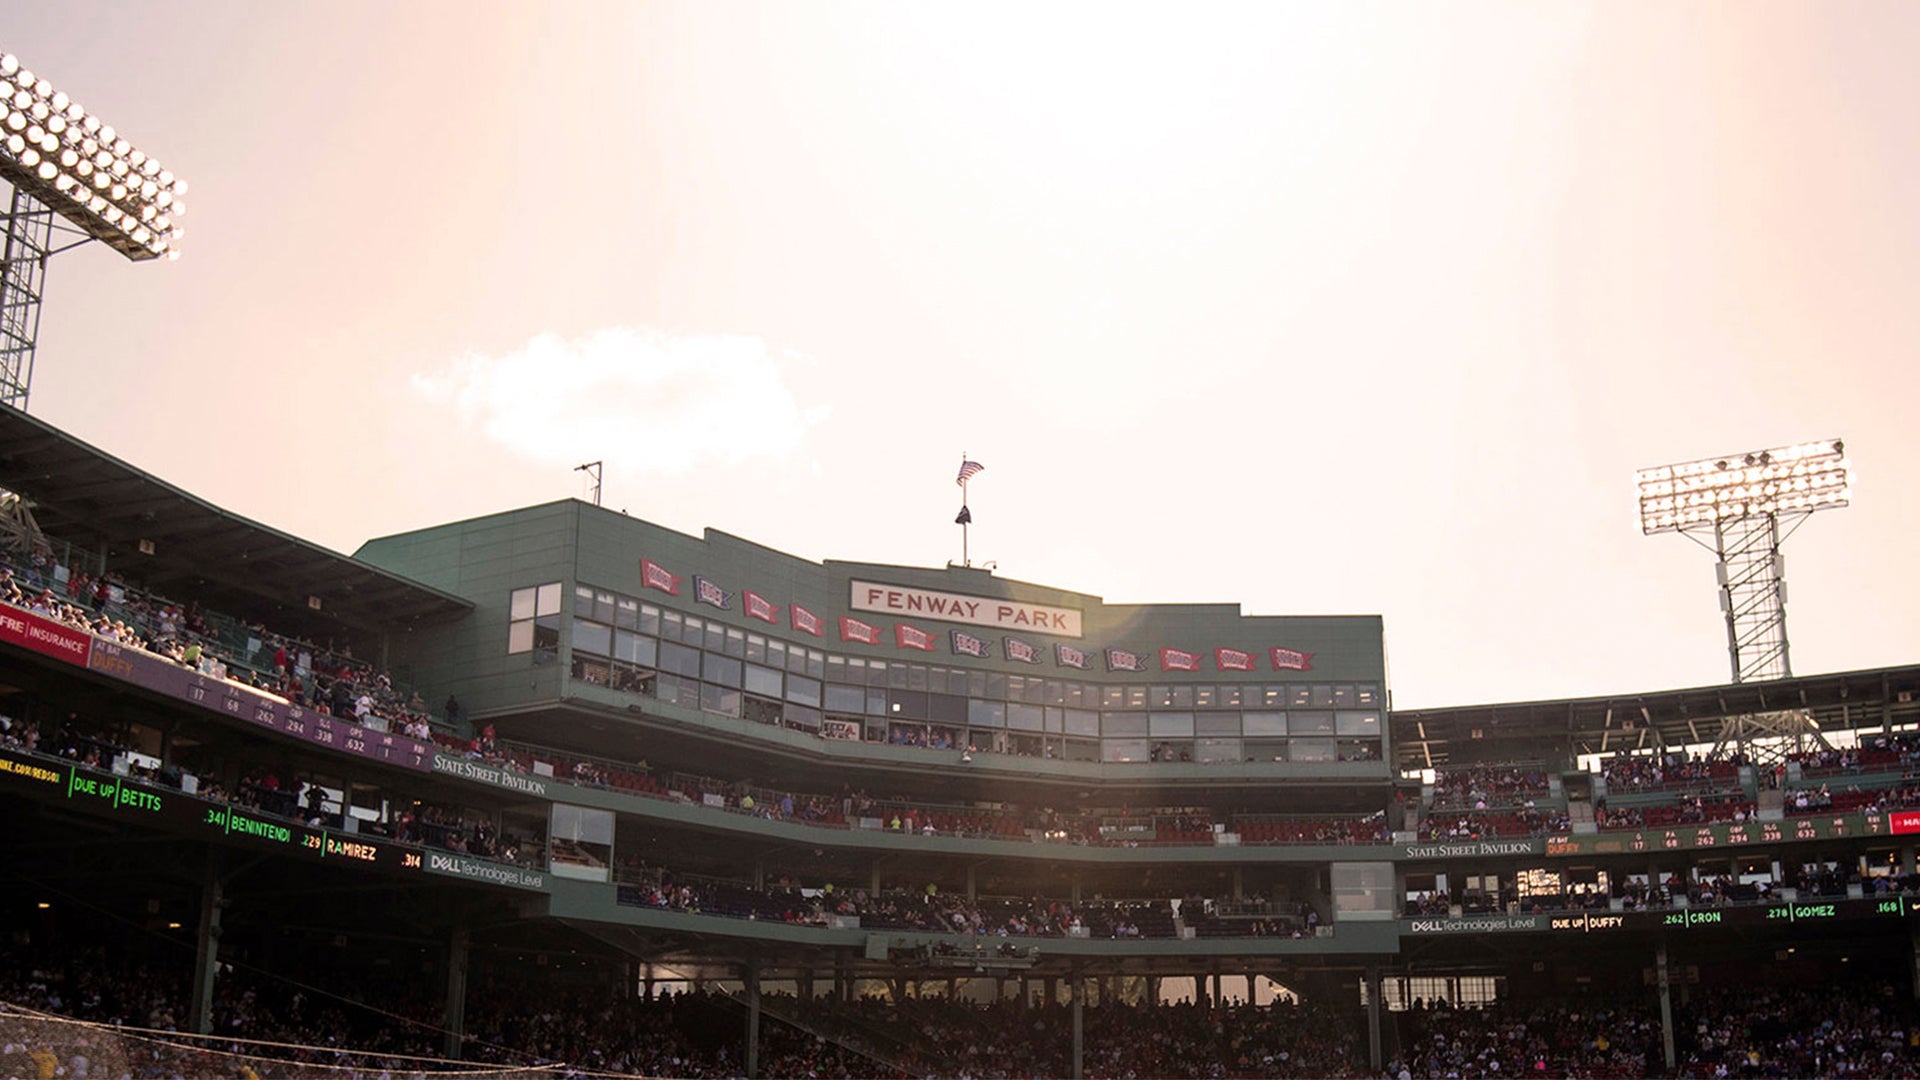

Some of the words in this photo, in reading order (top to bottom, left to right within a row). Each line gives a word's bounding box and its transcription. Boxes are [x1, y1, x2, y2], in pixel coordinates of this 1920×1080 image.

[868, 589, 980, 618] FENWAY
[998, 606, 1067, 630] PARK
[29, 626, 83, 654] INSURANCE
[95, 641, 105, 650] AT
[106, 644, 121, 655] BAT
[93, 651, 133, 677] DUFFY
[194, 688, 205, 700] 17
[227, 699, 239, 712] 68
[345, 738, 365, 752] .632
[415, 756, 421, 765] 7
[349, 727, 363, 737] OPS
[434, 755, 464, 777] STATE
[465, 763, 500, 785] STREET
[502, 772, 546, 795] PAVILION
[74, 777, 97, 797] DUE
[99, 782, 115, 798] UP
[121, 788, 162, 811] BETTS
[231, 815, 291, 843] BENINTENDI
[327, 842, 377, 861] RAMIREZ
[401, 854, 421, 869] .314
[1548, 843, 1579, 854] DUFFY
[1634, 841, 1643, 850] 17
[1872, 824, 1878, 833] 7
[1407, 846, 1438, 858] STATE
[1439, 845, 1477, 857] STREET
[1480, 843, 1531, 855] PAVILION
[431, 855, 461, 874] DELL
[461, 861, 518, 884] Technologies
[520, 870, 543, 888] Level
[1412, 921, 1442, 932] DELL
[1442, 919, 1507, 932] Technologies
[1509, 917, 1536, 928] Level
[1552, 918, 1570, 929] DUE
[1572, 918, 1584, 928] UP
[1590, 917, 1623, 928] DUFFY
[1662, 914, 1684, 925] .262
[1690, 912, 1721, 924] CRON
[1766, 908, 1788, 919] .278
[1795, 905, 1835, 917] GOMEZ
[1876, 902, 1897, 913] .168
